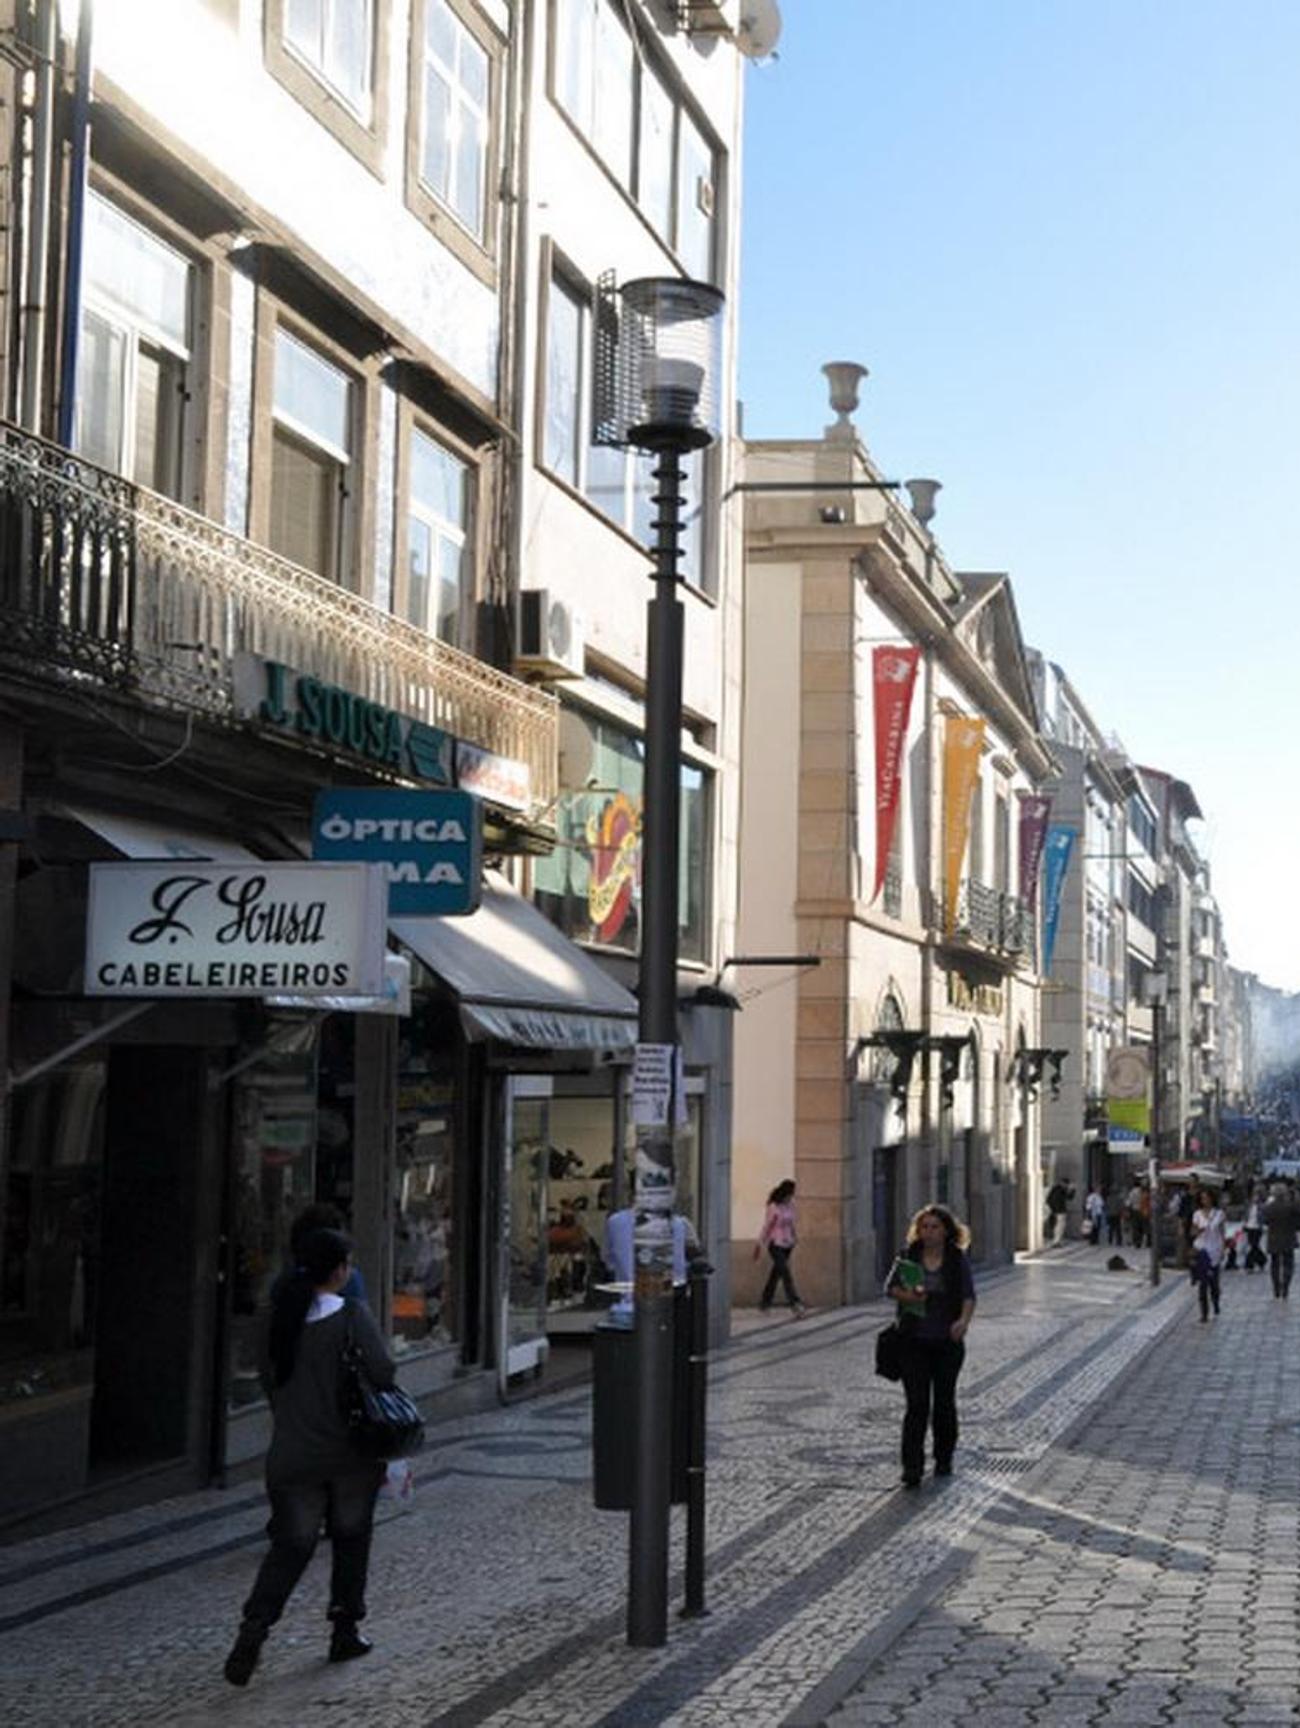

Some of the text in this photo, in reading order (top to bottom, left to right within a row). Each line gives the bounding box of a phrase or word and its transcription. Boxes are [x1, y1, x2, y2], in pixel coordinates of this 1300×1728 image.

[296, 676, 403, 765] SOUSA
[320, 813, 467, 842] ÓPTICA
[388, 861, 465, 884] MA
[216, 875, 328, 946] Sousa
[98, 961, 350, 988] CABELEIREIROS
